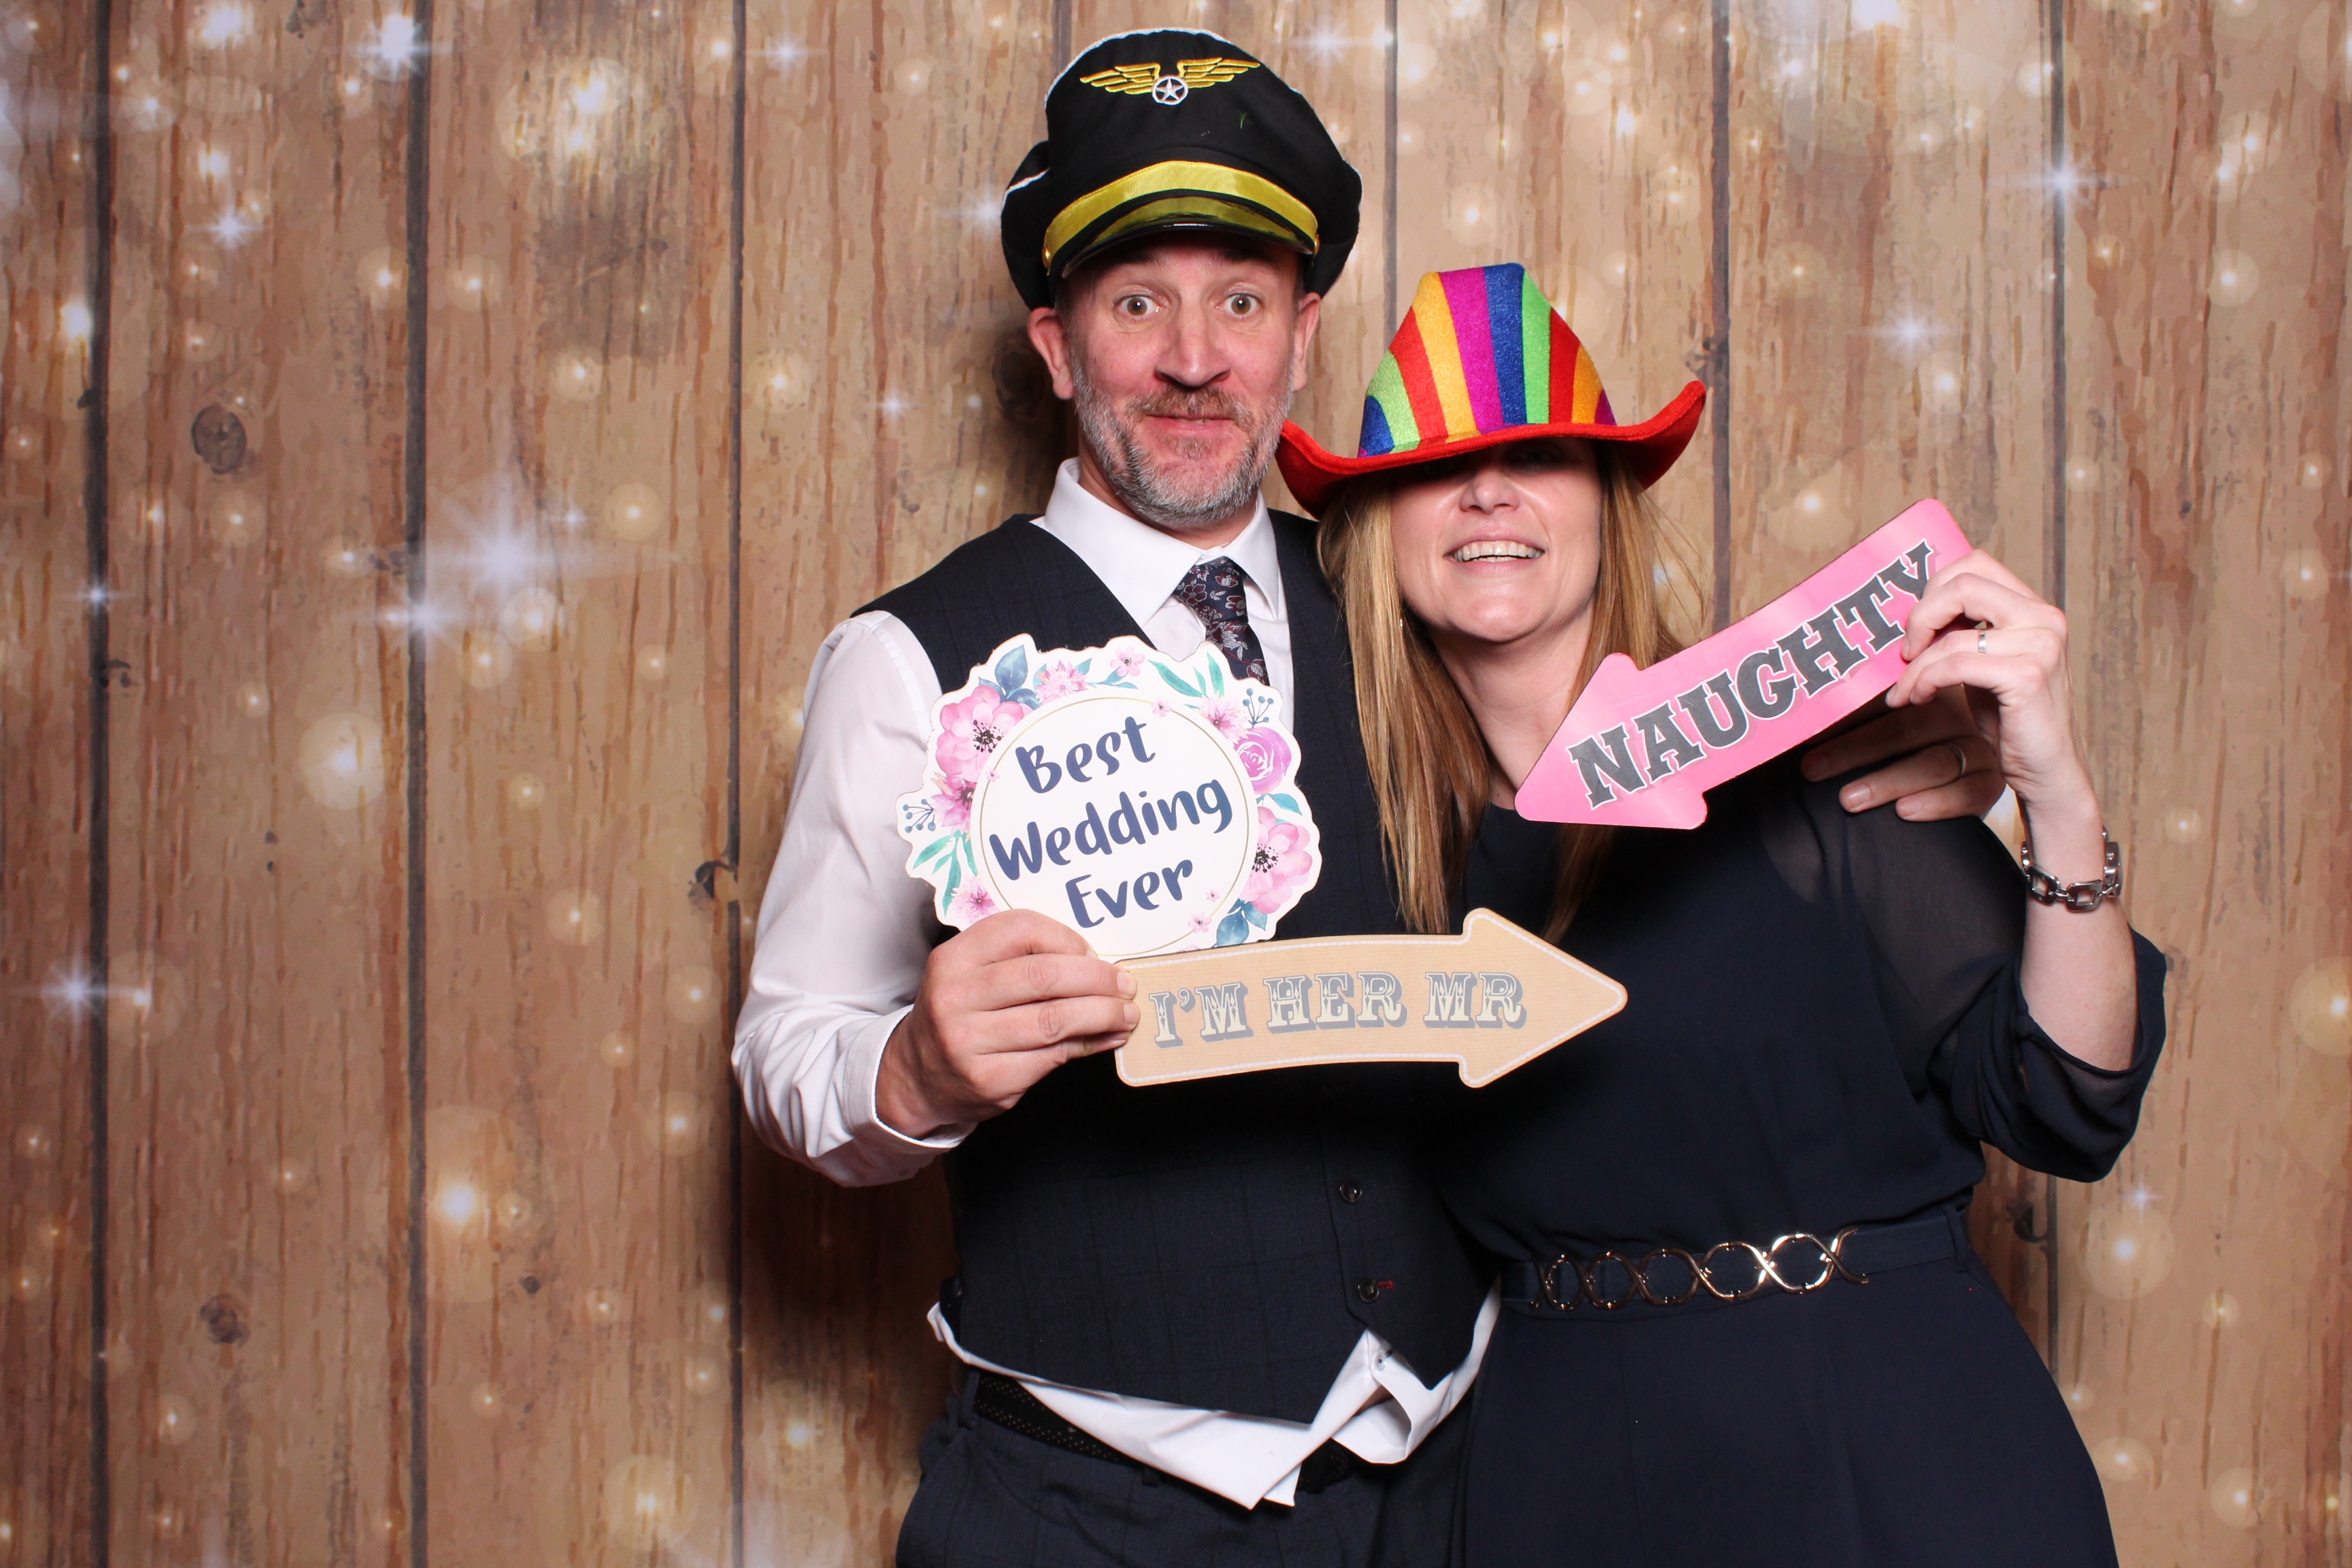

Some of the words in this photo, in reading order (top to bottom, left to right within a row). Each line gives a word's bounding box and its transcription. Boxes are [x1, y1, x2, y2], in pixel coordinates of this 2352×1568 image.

[1567, 539, 1934, 810] NAUGHTY
[1015, 717, 1156, 794] Best
[989, 779, 1232, 881] Wedding
[1065, 860, 1193, 928] Ever
[1148, 982, 1254, 1049] I'M
[1262, 971, 1407, 1033] HER
[1423, 971, 1527, 1029] MR
